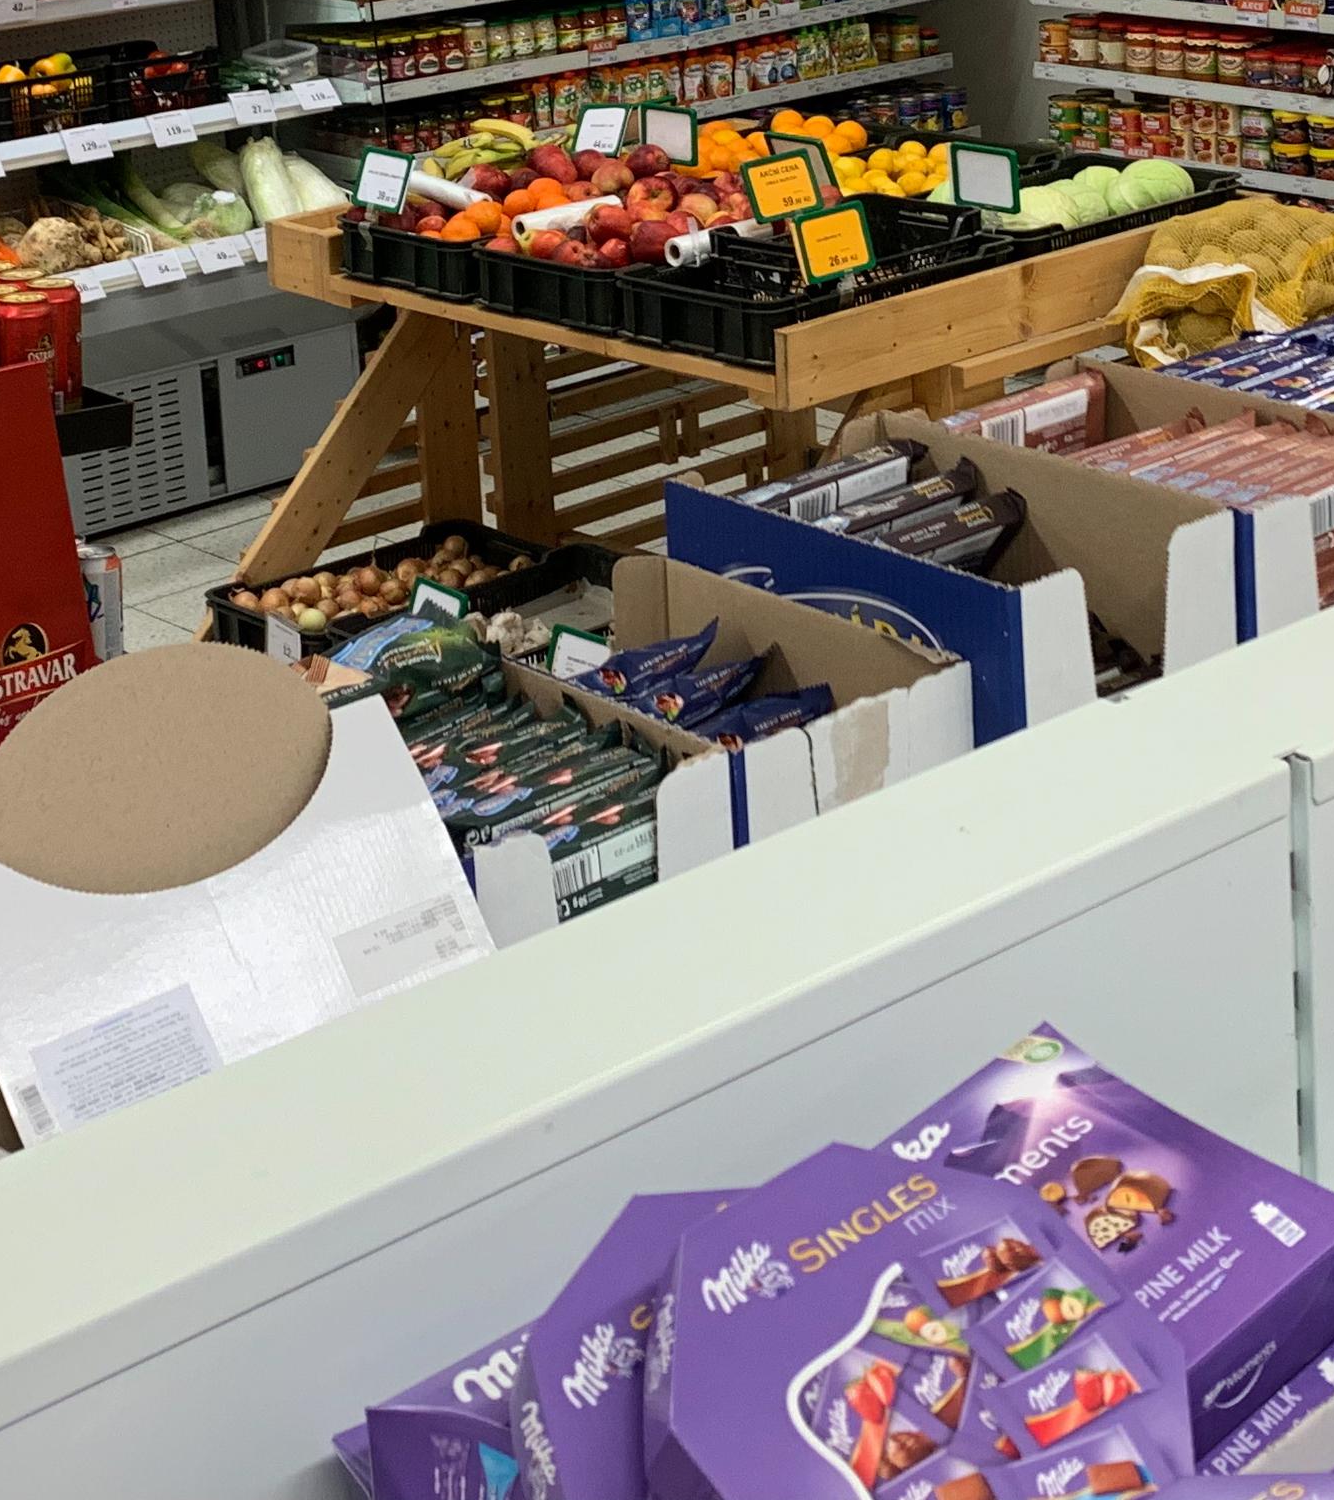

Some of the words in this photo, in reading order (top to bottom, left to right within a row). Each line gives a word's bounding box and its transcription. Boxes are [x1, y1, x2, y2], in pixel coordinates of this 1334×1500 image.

[1242, 2, 1264, 11] AKCE
[1290, 6, 1312, 15] AKCE
[993, 1114, 1094, 1186] ments
[789, 1174, 939, 1275] SINGLES
[903, 1196, 956, 1237] mix
[701, 1240, 771, 1313] Milka
[1134, 1260, 1184, 1309] PINE
[1178, 1226, 1232, 1272] MILK
[1251, 1386, 1303, 1434] MILK
